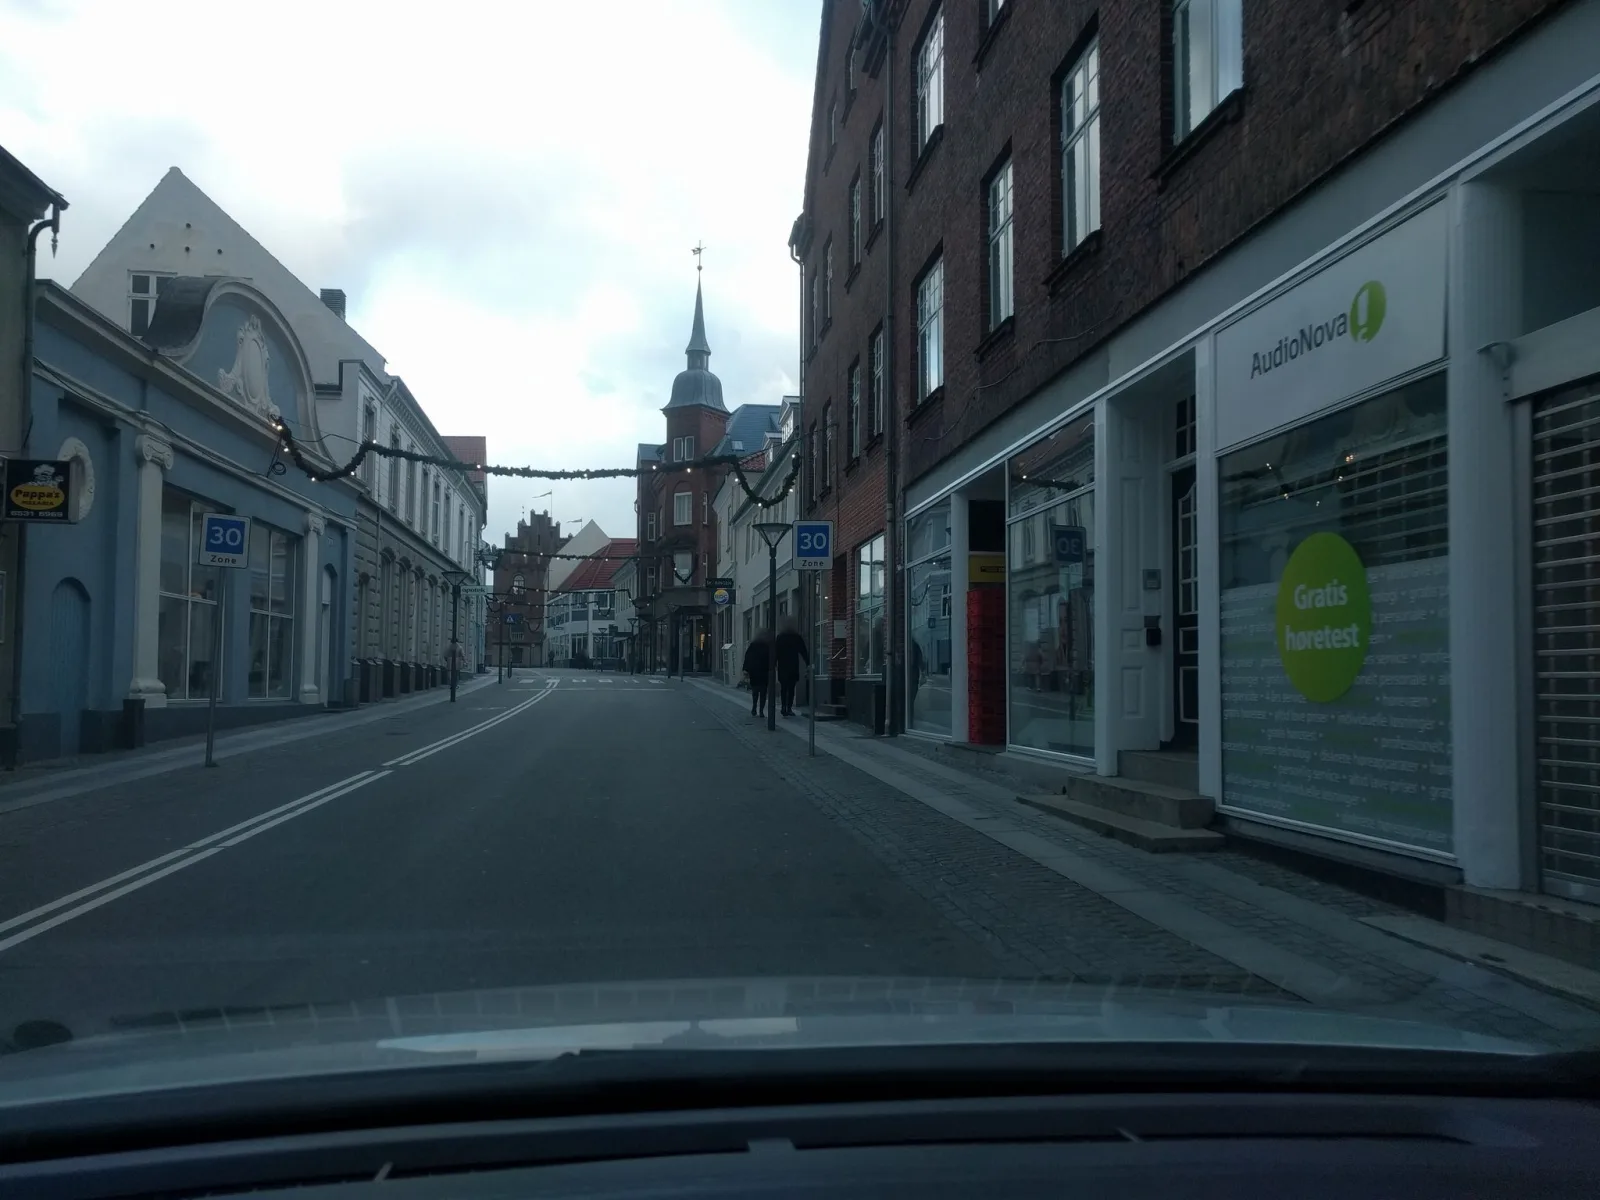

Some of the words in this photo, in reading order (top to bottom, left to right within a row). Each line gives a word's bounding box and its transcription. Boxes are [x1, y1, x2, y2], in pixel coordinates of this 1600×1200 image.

[1251, 312, 1348, 379] AudioNova
[210, 526, 242, 546] 30
[800, 532, 827, 550] 30
[211, 554, 237, 565] Zone
[802, 559, 824, 567] Zone
[1294, 578, 1348, 610] Gratis
